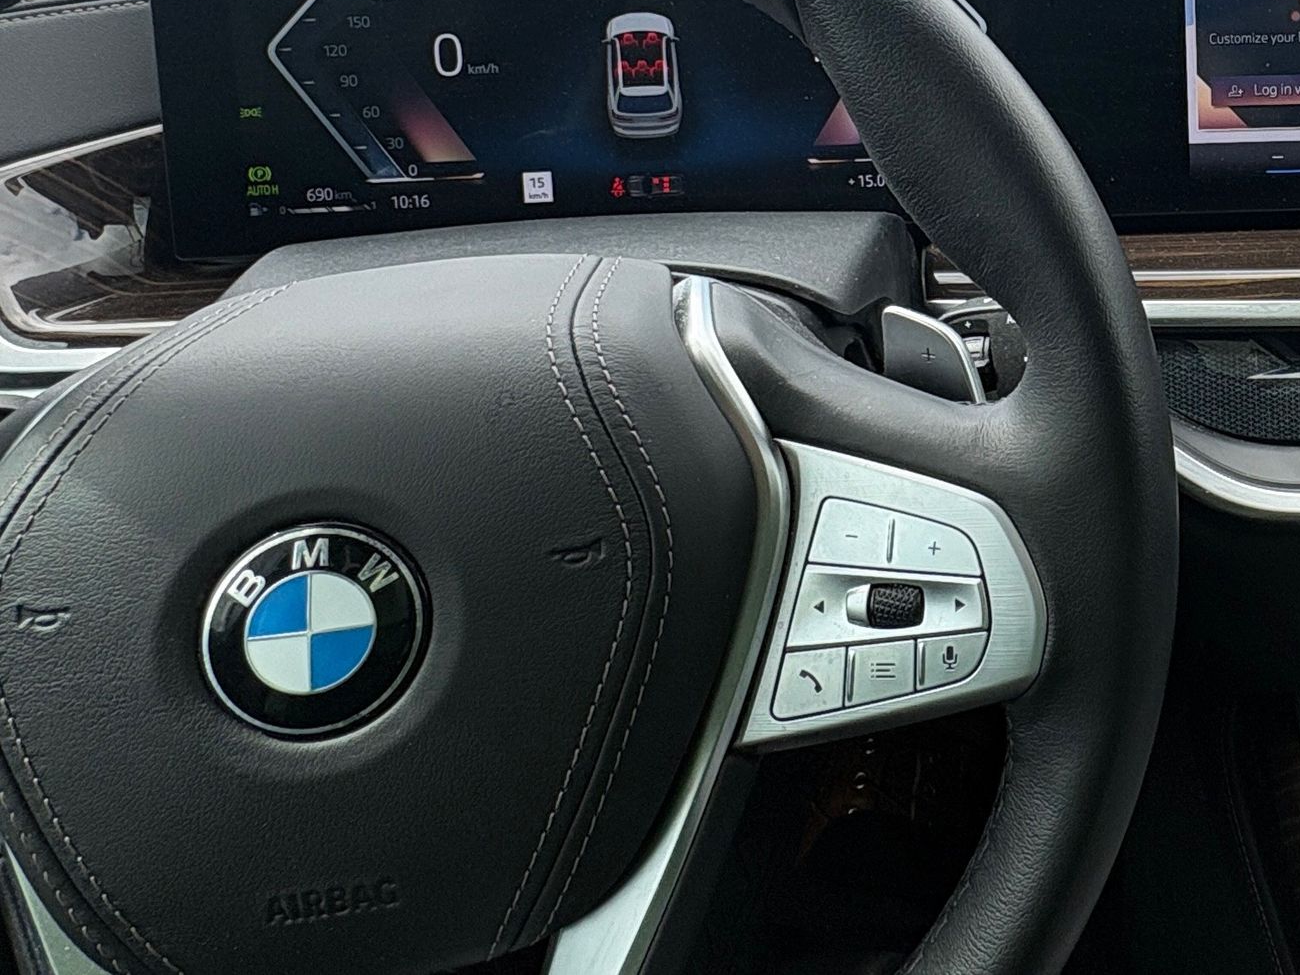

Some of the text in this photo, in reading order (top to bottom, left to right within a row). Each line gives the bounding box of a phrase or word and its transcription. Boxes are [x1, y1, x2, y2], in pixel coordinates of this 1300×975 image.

[346, 16, 370, 28] 150
[1209, 32, 1268, 45] Customize
[1271, 33, 1295, 45] your
[323, 44, 347, 57] 120
[434, 33, 499, 77] 0 km/h
[340, 75, 358, 87] 90
[1254, 84, 1277, 97] Log
[1281, 83, 1292, 95] in
[362, 106, 380, 118] 60
[385, 137, 404, 149] 30
[408, 164, 418, 176] 0
[529, 177, 545, 189] 15
[247, 184, 279, 196] AUTO H
[307, 188, 352, 202] 690 km
[528, 192, 549, 200] km/h
[390, 195, 430, 209] 10:16
[227, 537, 400, 608] BMW
[265, 878, 401, 925] AIRBAG
